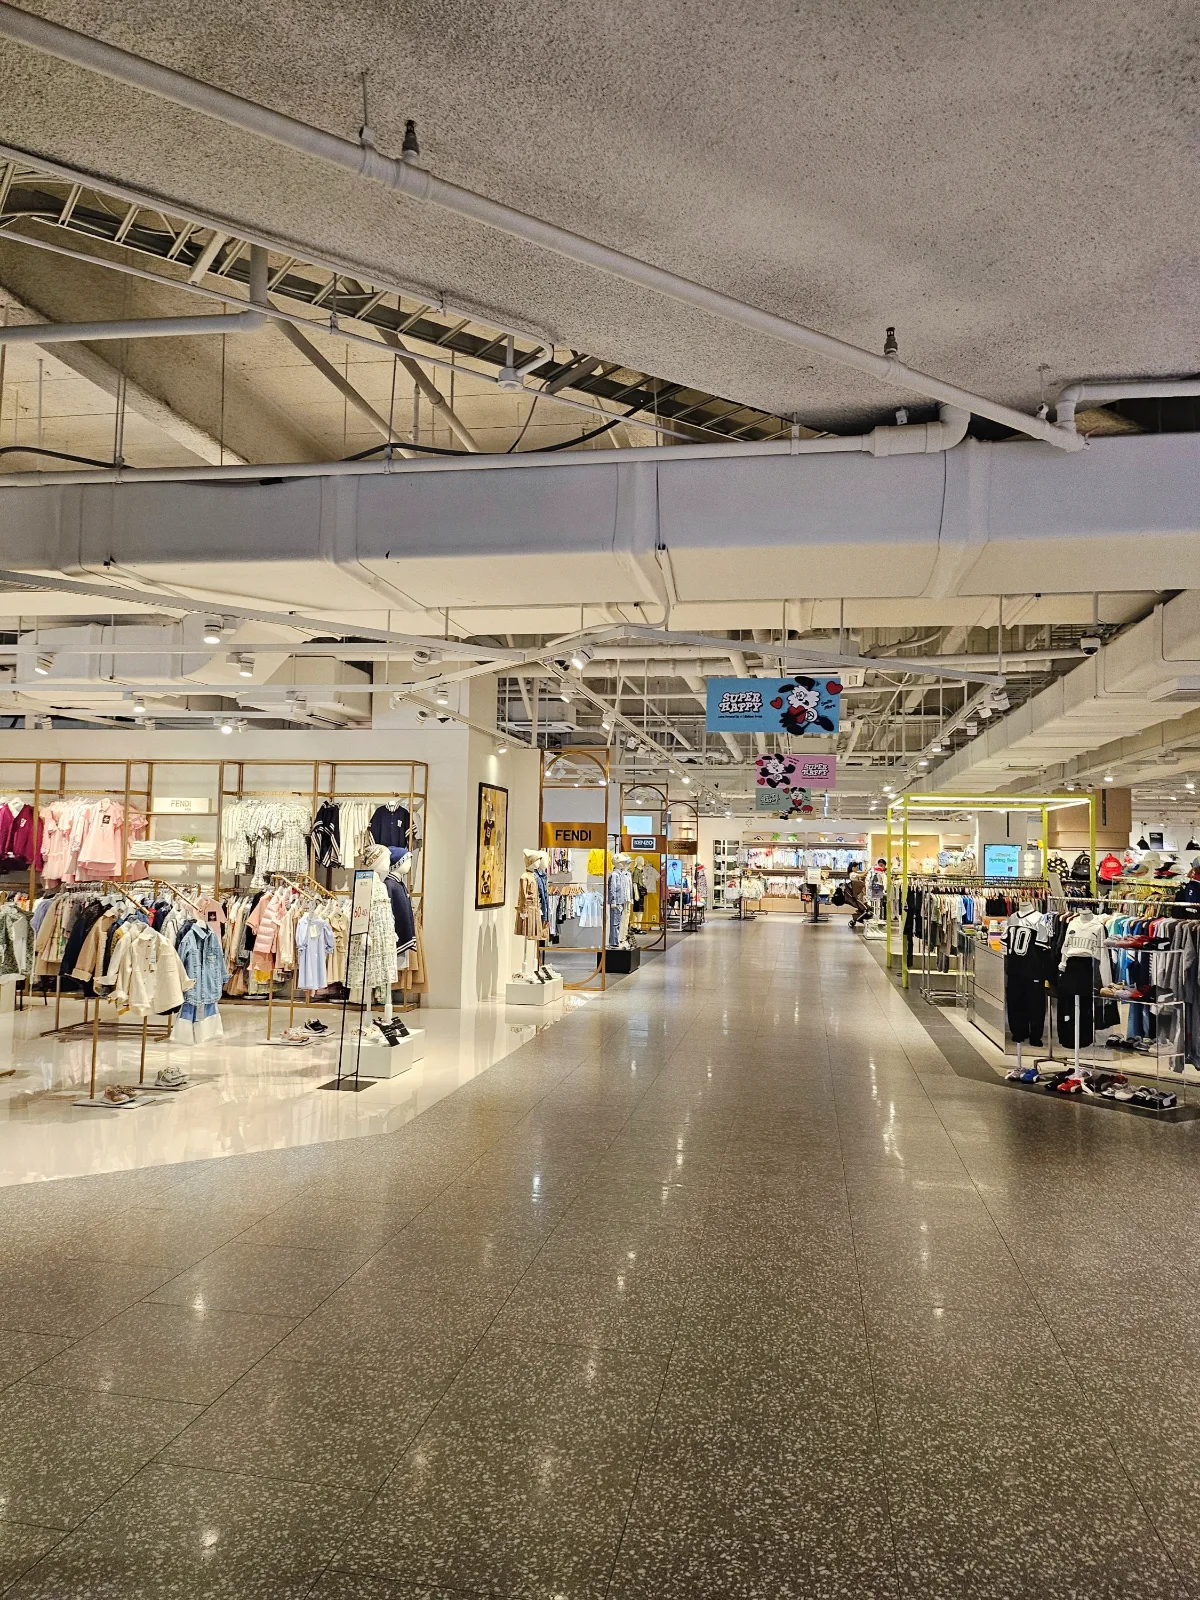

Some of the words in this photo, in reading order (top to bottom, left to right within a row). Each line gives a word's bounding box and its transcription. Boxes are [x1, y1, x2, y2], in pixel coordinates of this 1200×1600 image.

[722, 692, 762, 702] SUPER
[719, 702, 762, 712] HAPPY
[170, 799, 192, 808] FENDI
[555, 829, 592, 842] FENDI
[1009, 926, 1031, 957] 10
